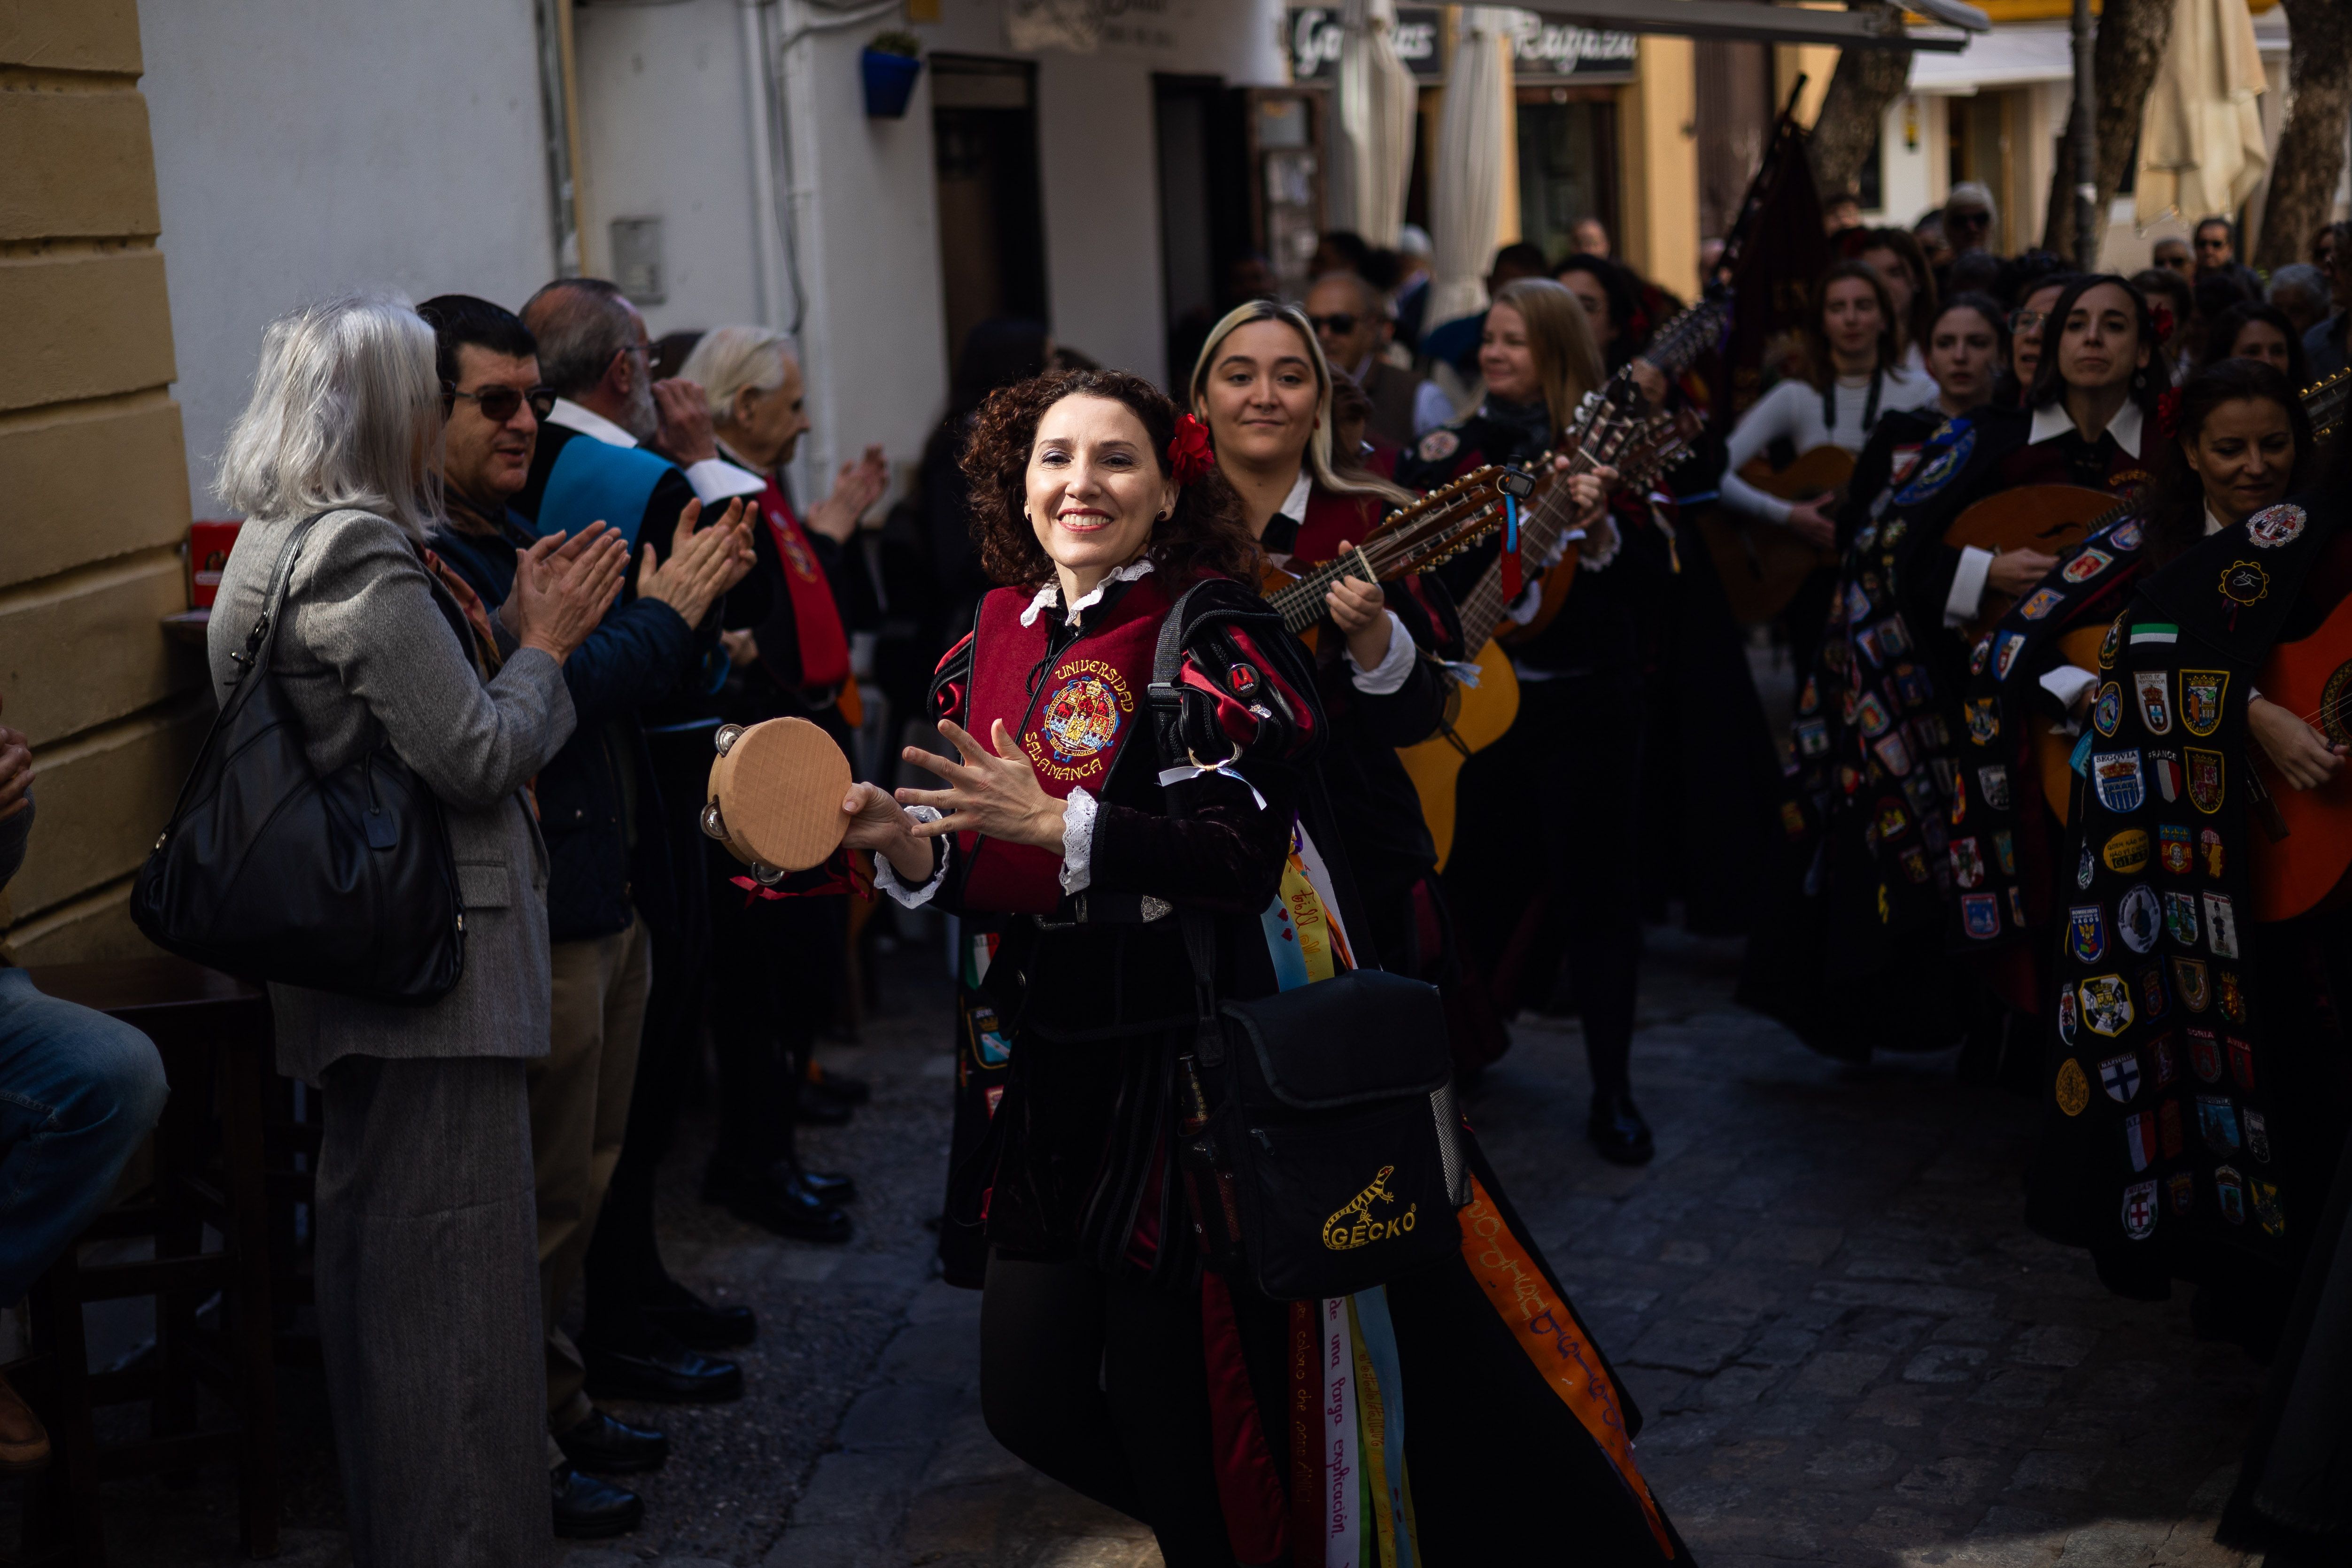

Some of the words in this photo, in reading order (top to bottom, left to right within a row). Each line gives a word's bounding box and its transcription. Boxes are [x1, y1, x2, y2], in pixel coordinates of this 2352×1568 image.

[1055, 659, 1134, 712] UNIVERSIDAD
[2186, 716, 2219, 733] SALAMANCA
[1025, 732, 1103, 781] SALAMANCA
[2096, 751, 2137, 763] SEGOVIA
[2148, 749, 2177, 762] FRANCE
[2072, 916, 2100, 925] LAGOS
[2187, 1027, 2215, 1039] SORIA
[2101, 1053, 2133, 1069] MARSEILLE
[1331, 1212, 1416, 1245] GECKO
[1329, 1299, 1343, 1322] de
[1330, 1333, 1341, 1369] una
[1297, 1389, 1312, 1412] che
[1326, 1439, 1350, 1540] explicación.
